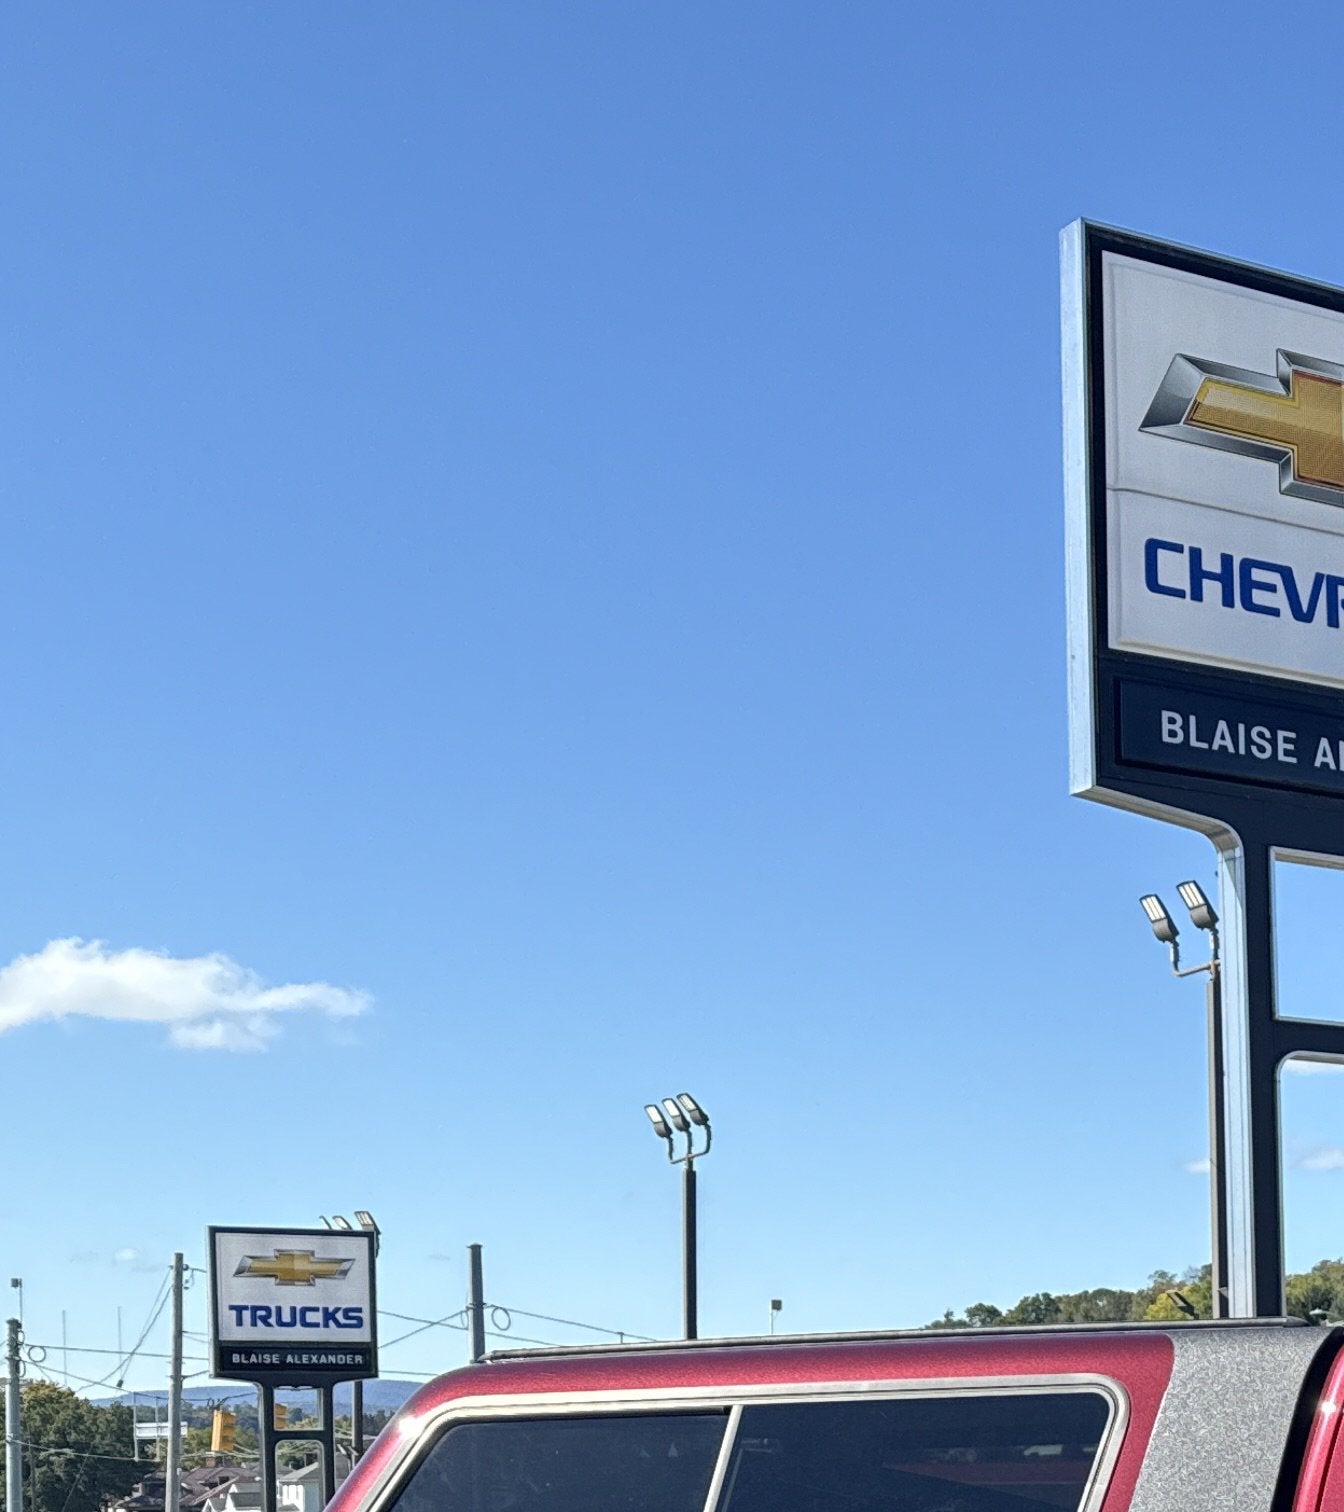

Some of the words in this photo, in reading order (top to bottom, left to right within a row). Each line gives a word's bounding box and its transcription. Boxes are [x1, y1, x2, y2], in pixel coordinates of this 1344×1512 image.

[1161, 710, 1299, 764] BLAISE
[228, 1304, 363, 1329] TRUCKS
[231, 1353, 280, 1364] BLAISE
[285, 1353, 363, 1365] ALEXANDER
